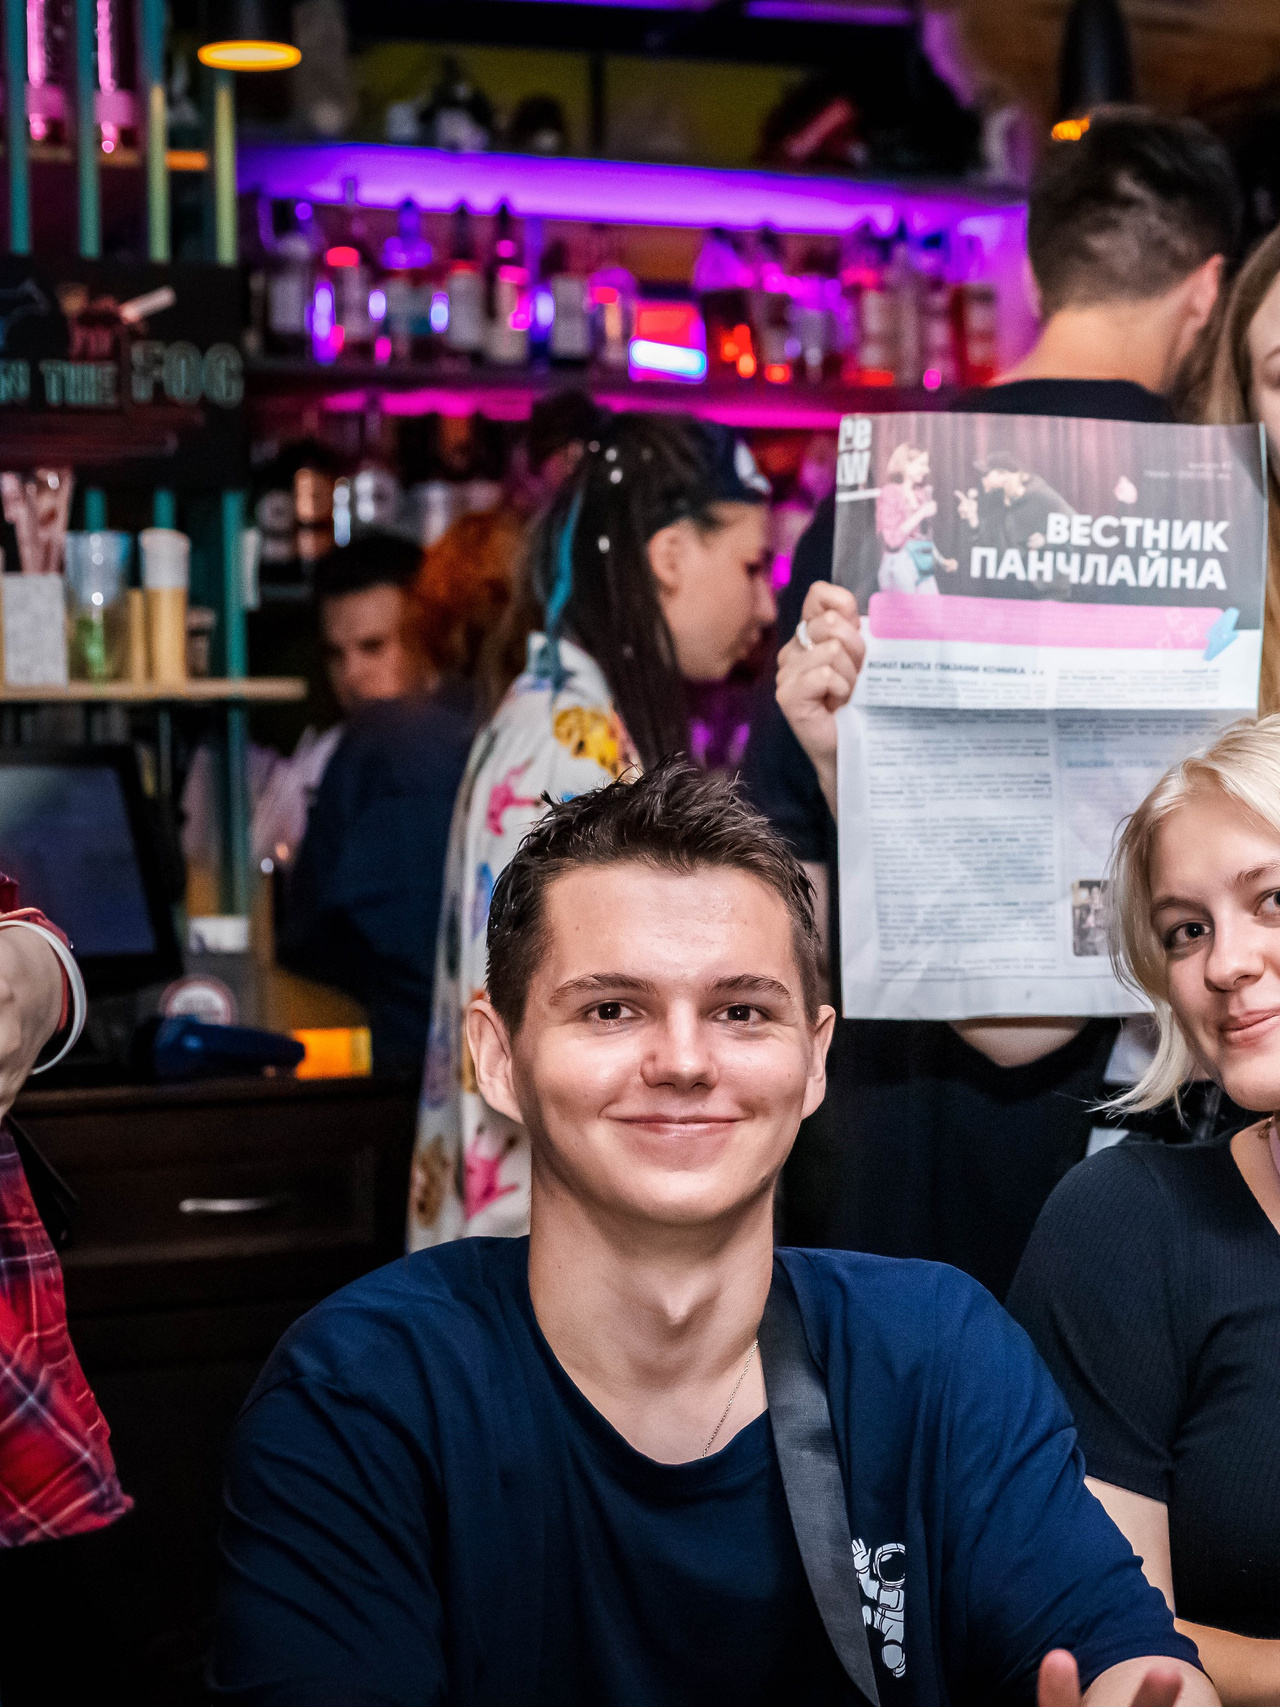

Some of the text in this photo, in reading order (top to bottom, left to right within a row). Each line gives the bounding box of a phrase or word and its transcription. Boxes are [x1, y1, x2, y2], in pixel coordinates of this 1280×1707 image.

[131, 341, 243, 408] FOG
[1046, 512, 1230, 552] ВЕСТНИК
[970, 546, 1227, 590] ПАНЧЛАЙНА
